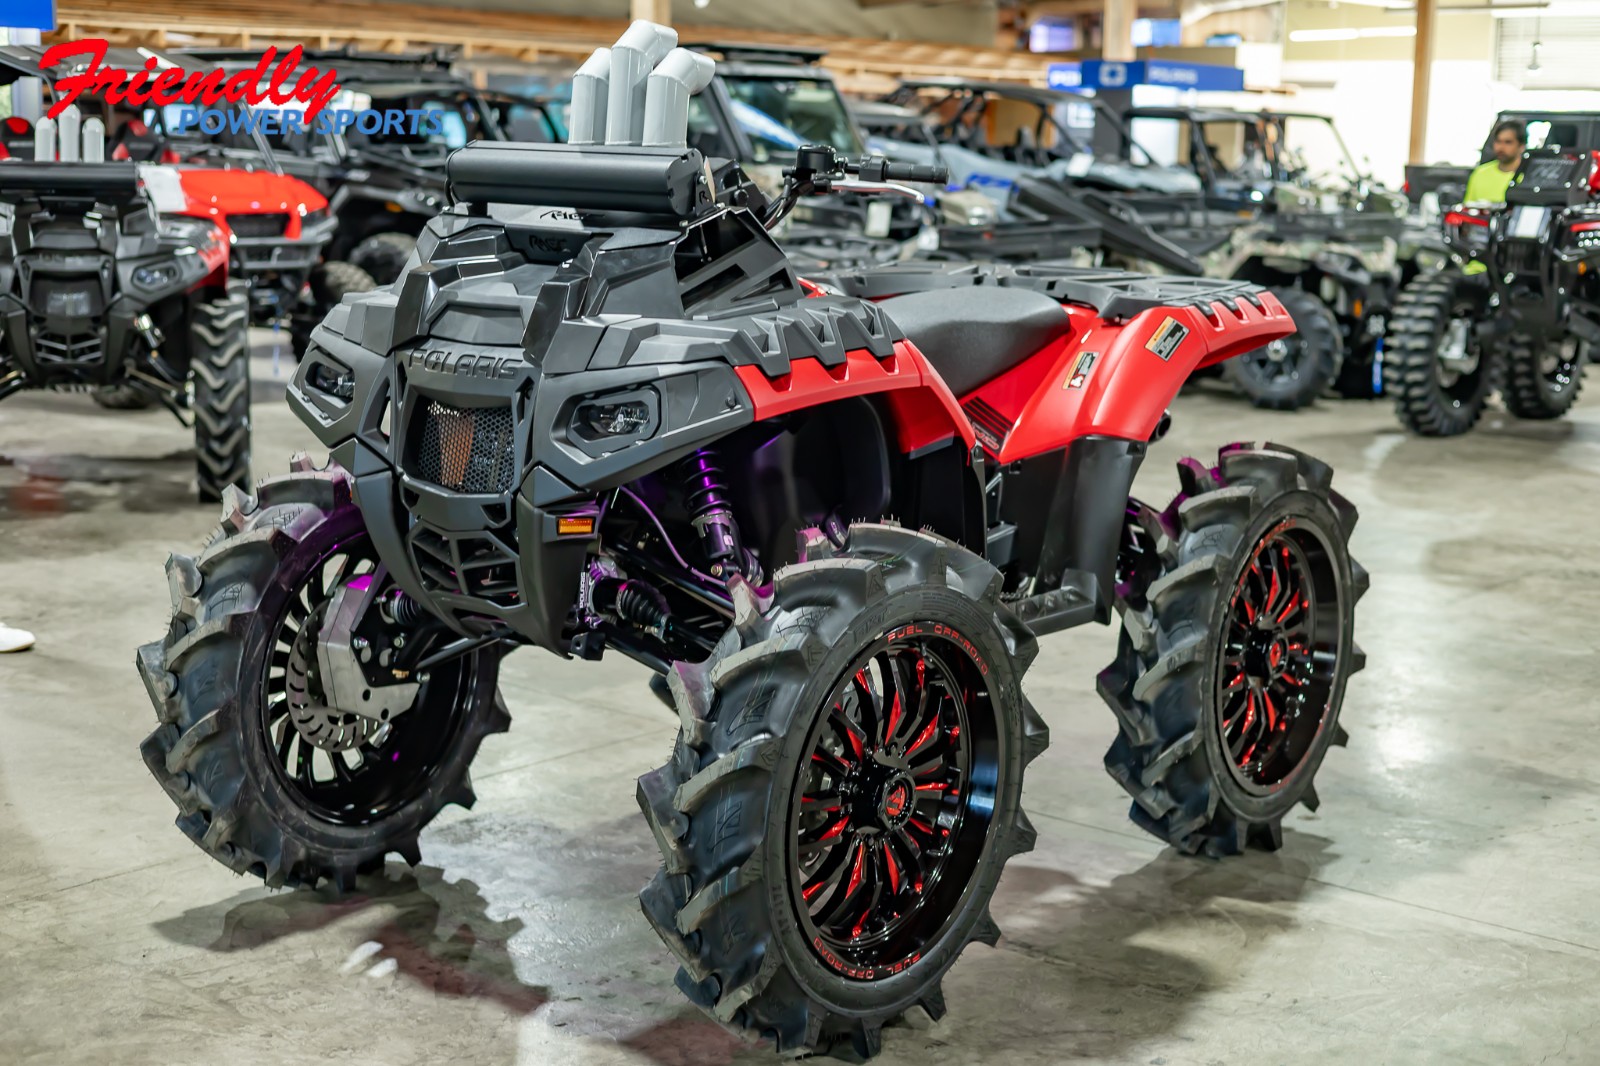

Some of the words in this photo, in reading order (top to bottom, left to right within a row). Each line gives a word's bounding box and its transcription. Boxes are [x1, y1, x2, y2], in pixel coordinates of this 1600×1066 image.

[409, 347, 525, 380] POLARIS
[887, 624, 923, 645] FUEL
[934, 624, 989, 676] OFF-ROAD
[813, 936, 875, 980] OFF-ROAD
[885, 951, 921, 975] FUEL
